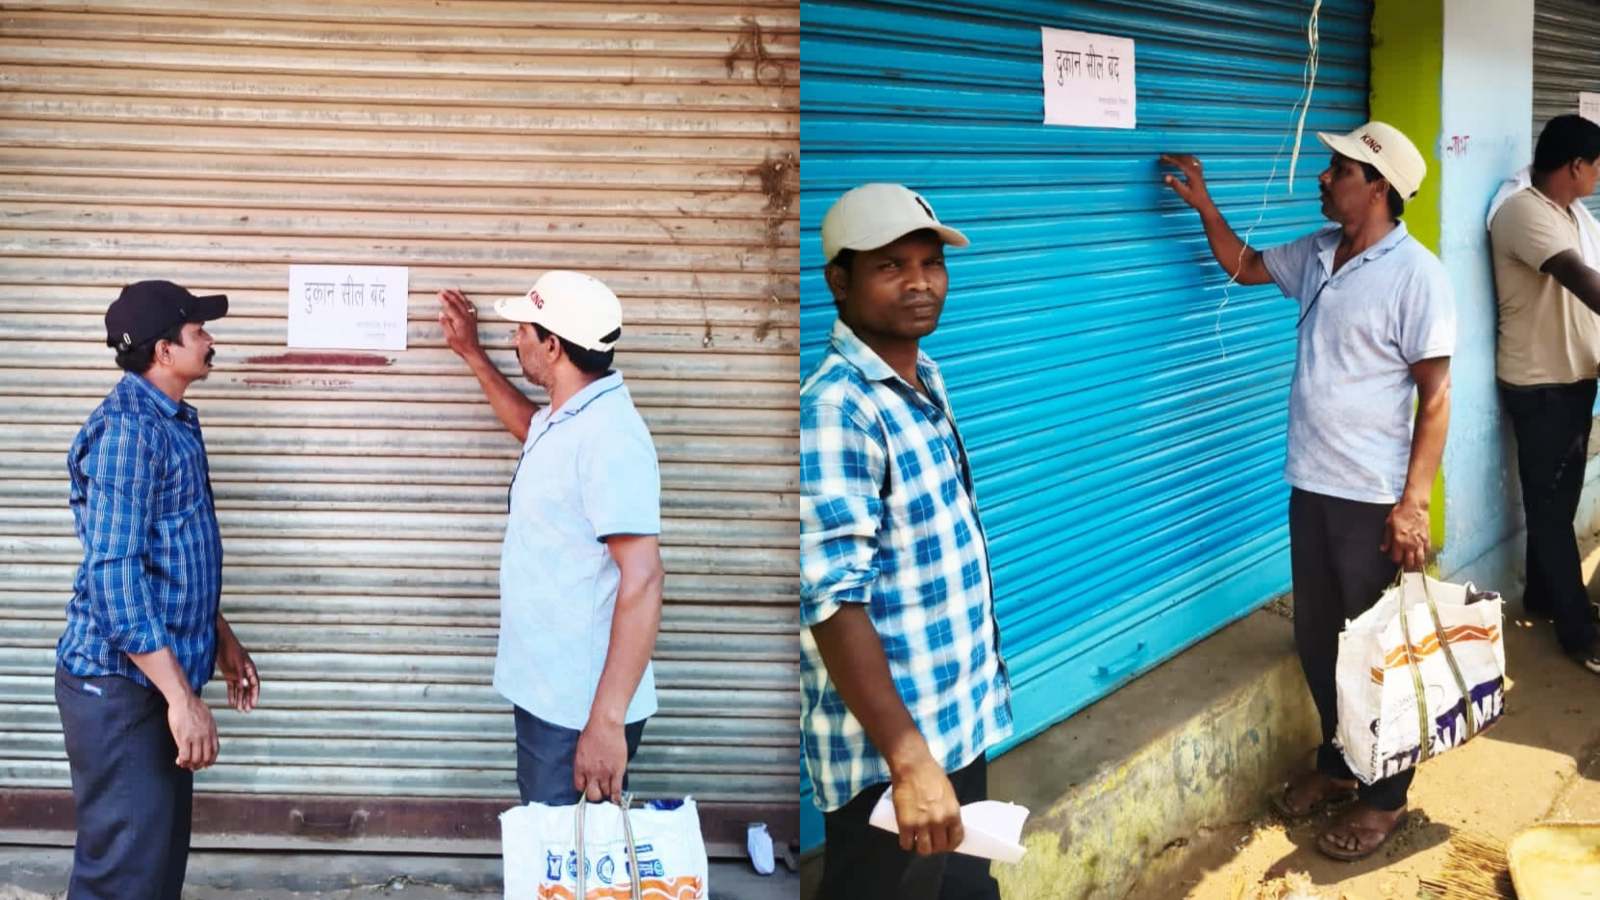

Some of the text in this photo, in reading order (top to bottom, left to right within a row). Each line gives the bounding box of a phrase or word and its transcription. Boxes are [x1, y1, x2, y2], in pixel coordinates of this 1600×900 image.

[1055, 43, 1120, 88] दुकान सील बंद
[1360, 133, 1382, 154] KING
[304, 282, 336, 314] दुकान
[341, 273, 365, 307] सील
